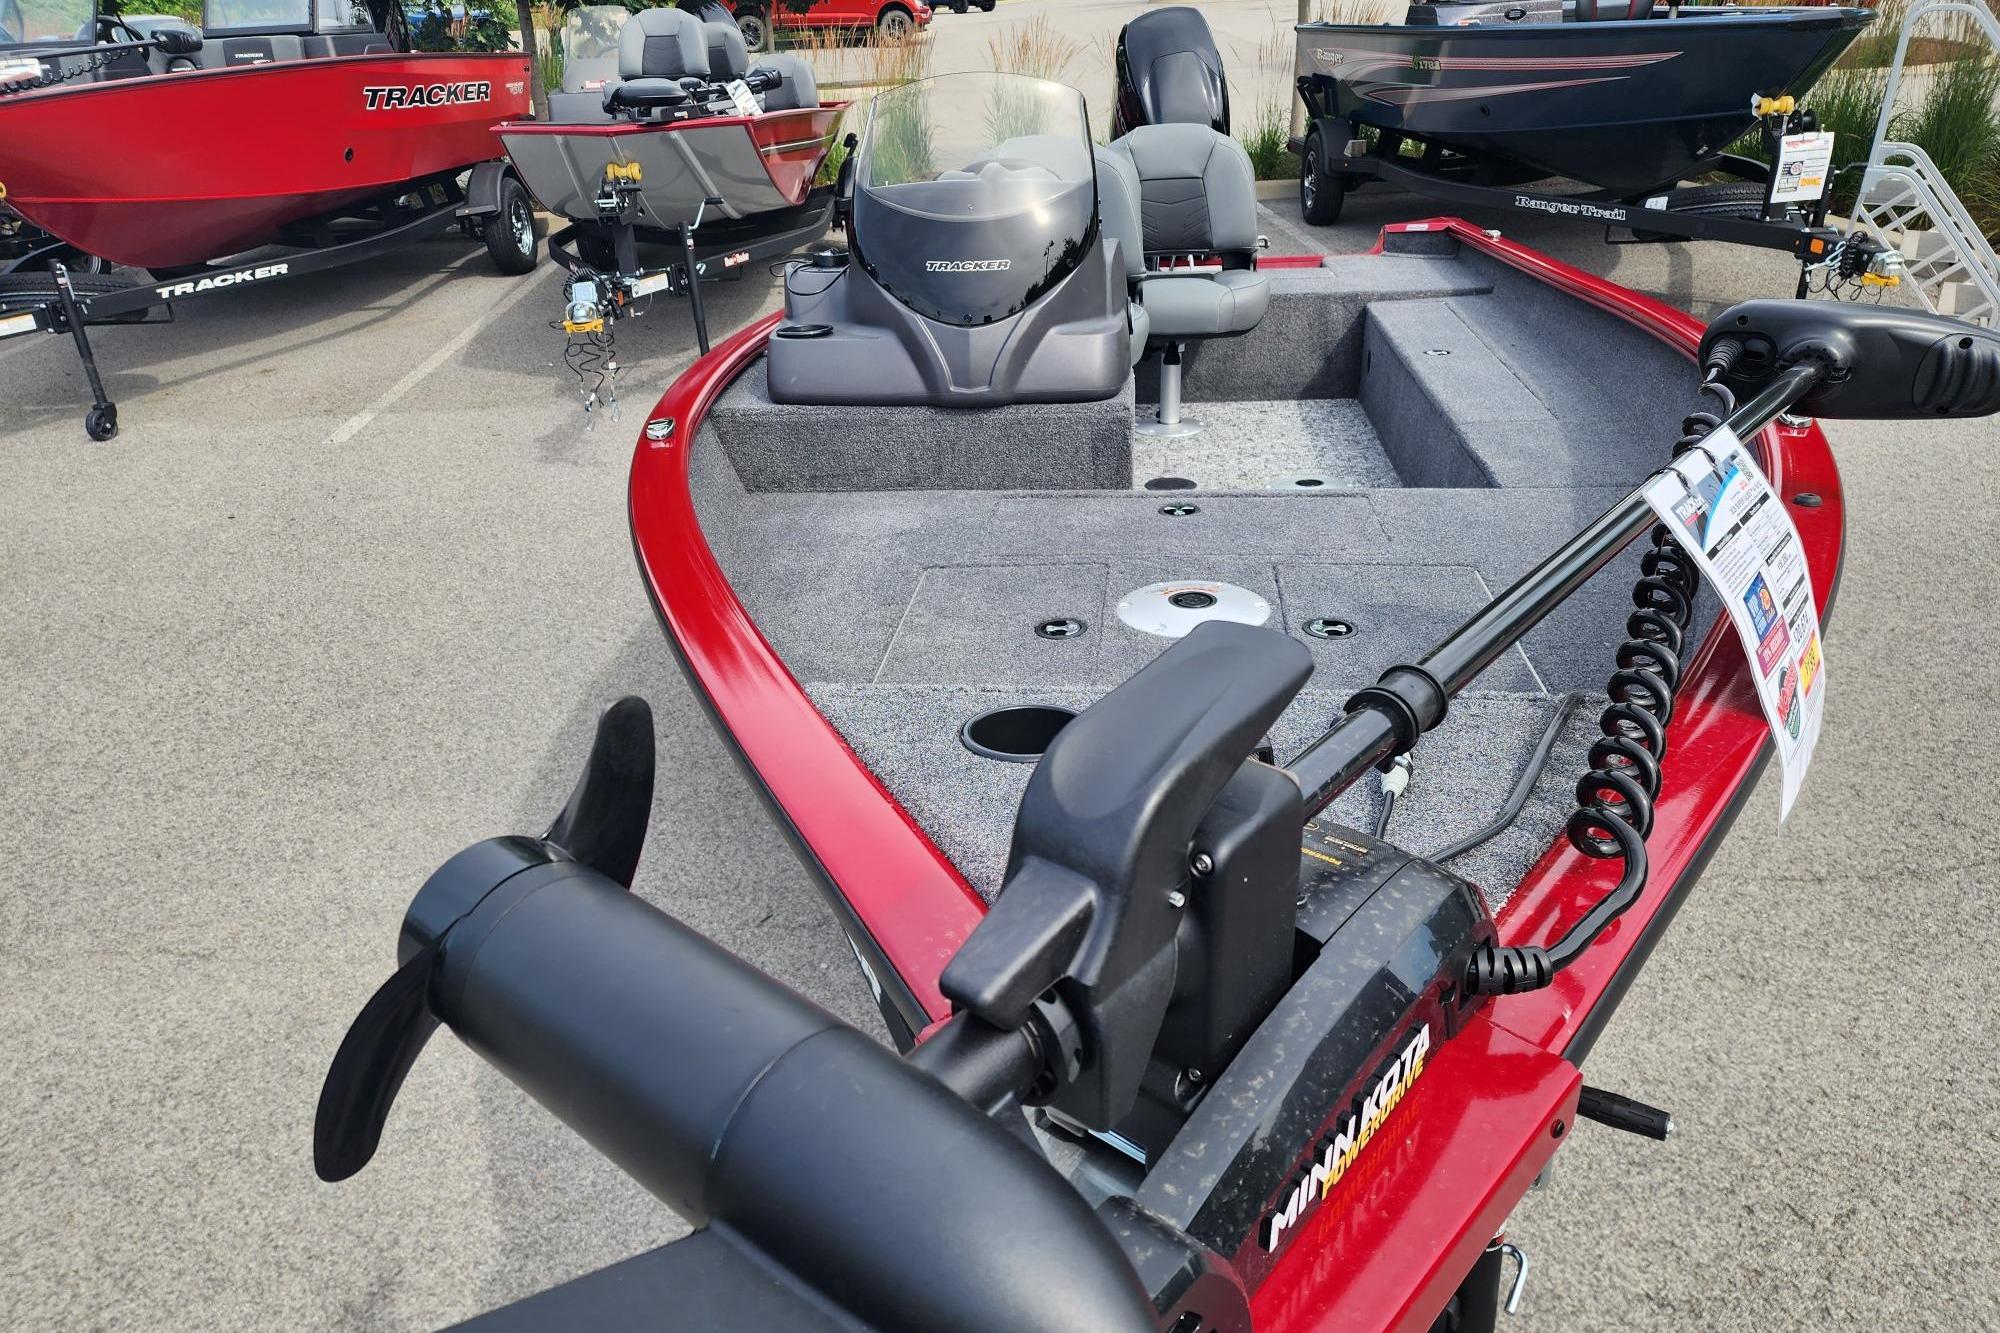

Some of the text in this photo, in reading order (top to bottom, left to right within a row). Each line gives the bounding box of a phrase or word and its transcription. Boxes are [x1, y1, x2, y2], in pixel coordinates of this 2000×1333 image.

[1317, 49, 1343, 65] Ranger
[363, 81, 491, 110] TRACKER
[1515, 196, 1626, 221] Ranger Trail
[926, 260, 1010, 272] TRACKER
[156, 263, 289, 299] TRACKER
[1268, 1023, 1430, 1253] MINN KOTA
[1322, 1055, 1424, 1200] POWERDRIVE
